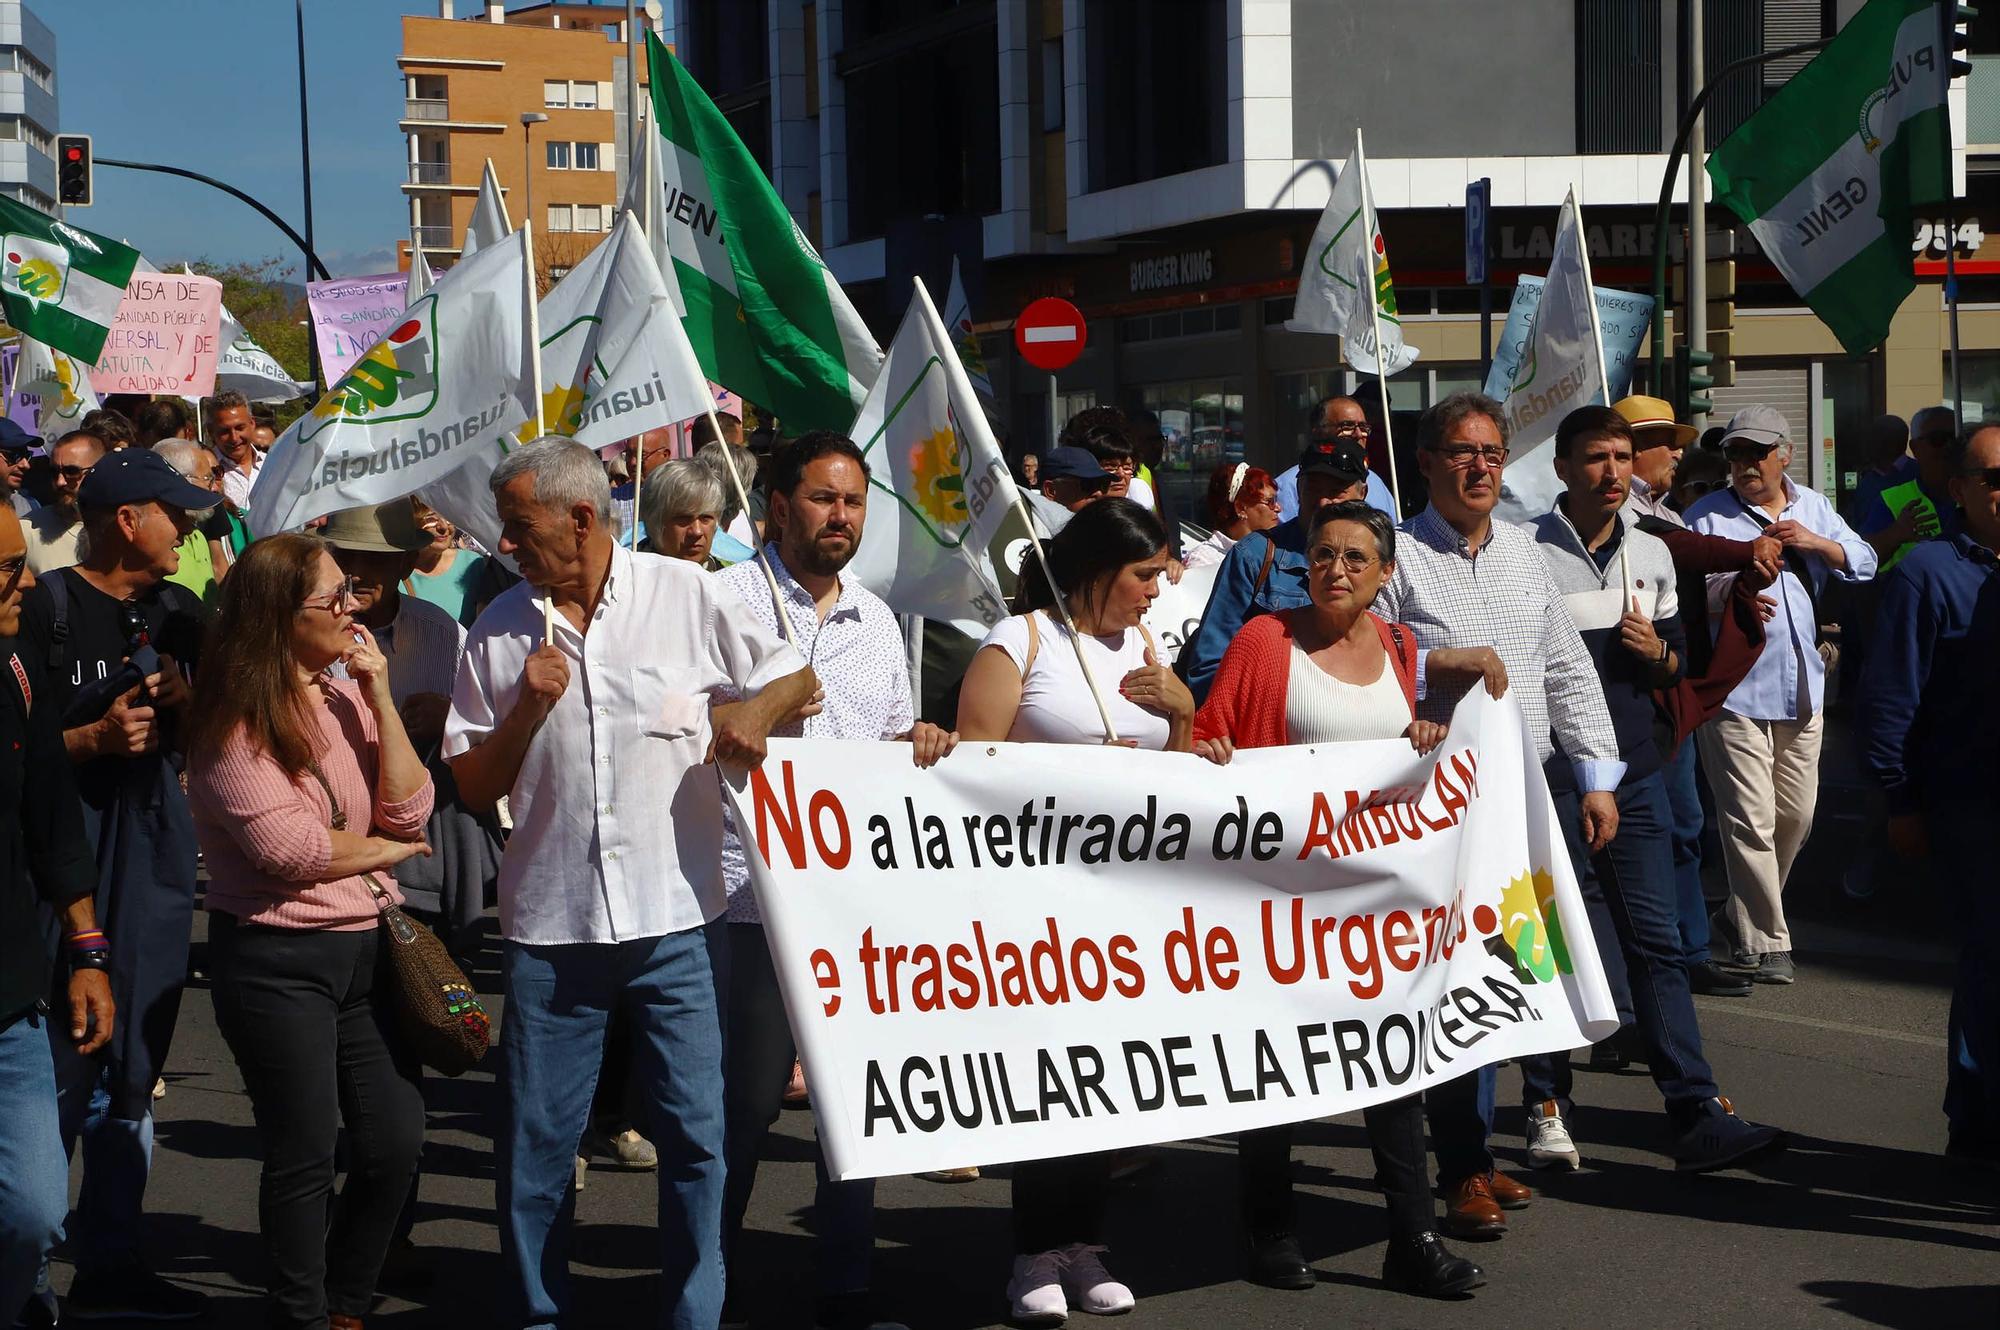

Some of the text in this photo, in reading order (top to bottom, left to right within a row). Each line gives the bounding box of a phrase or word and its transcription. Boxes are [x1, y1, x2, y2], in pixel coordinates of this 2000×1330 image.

[176, 281, 201, 301] DE
[1130, 248, 1213, 293] BURGER KING
[175, 332, 184, 356] Y
[194, 335, 214, 354] DE
[750, 760, 852, 870] No
[868, 813, 899, 870] a
[904, 796, 954, 870] la
[961, 794, 1192, 868] retirada
[1211, 795, 1284, 862] de
[859, 917, 1146, 1015] traslados
[1164, 906, 1240, 995] de
[864, 1044, 1120, 1138] AGUILAR
[1121, 1035, 1208, 1112] DE
[1212, 1028, 1296, 1104] LA
